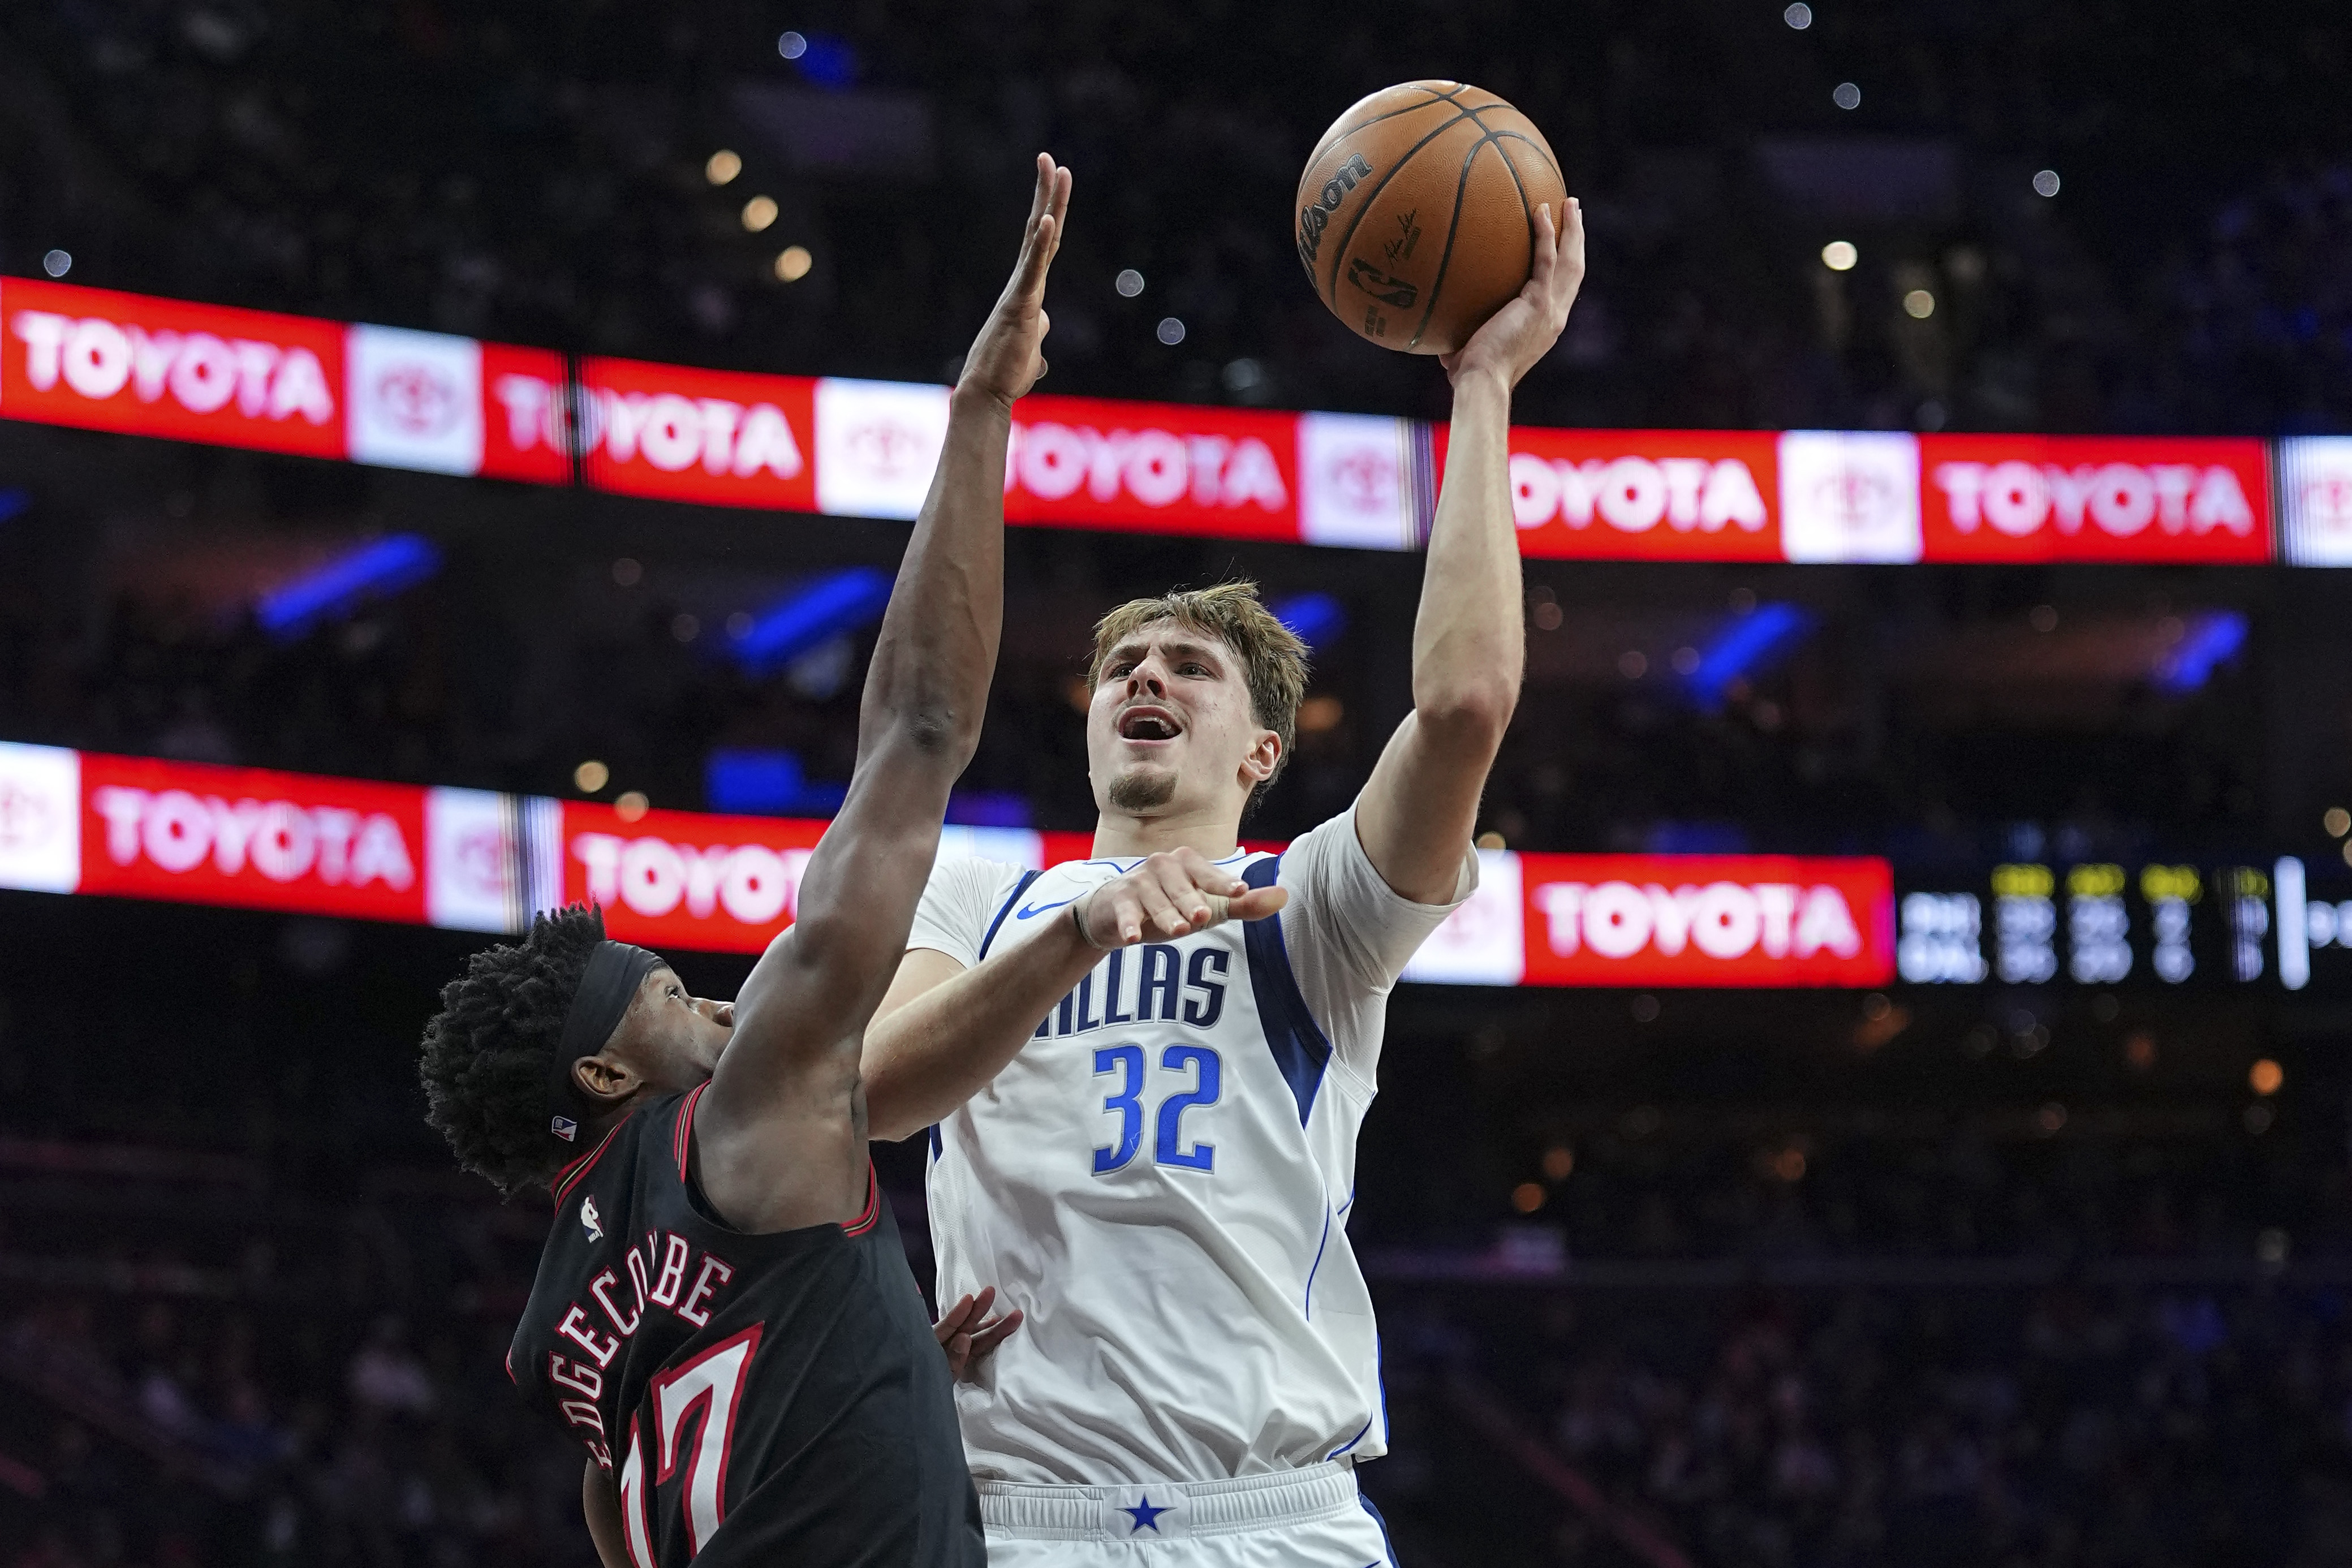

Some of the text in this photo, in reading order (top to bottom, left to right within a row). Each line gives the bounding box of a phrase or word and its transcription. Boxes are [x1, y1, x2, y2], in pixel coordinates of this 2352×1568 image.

[14, 311, 333, 425] TOYOTA
[1004, 422, 1287, 512] OYOTA
[1510, 454, 1768, 532] OYOTA
[1935, 460, 2254, 538] TOYOTA
[93, 786, 415, 893] TOYOTA
[572, 833, 815, 924] TOYO
[1532, 881, 1863, 960] TOYOTA
[1032, 944, 1233, 1041] LLAS
[1091, 1042, 1224, 1176] 32
